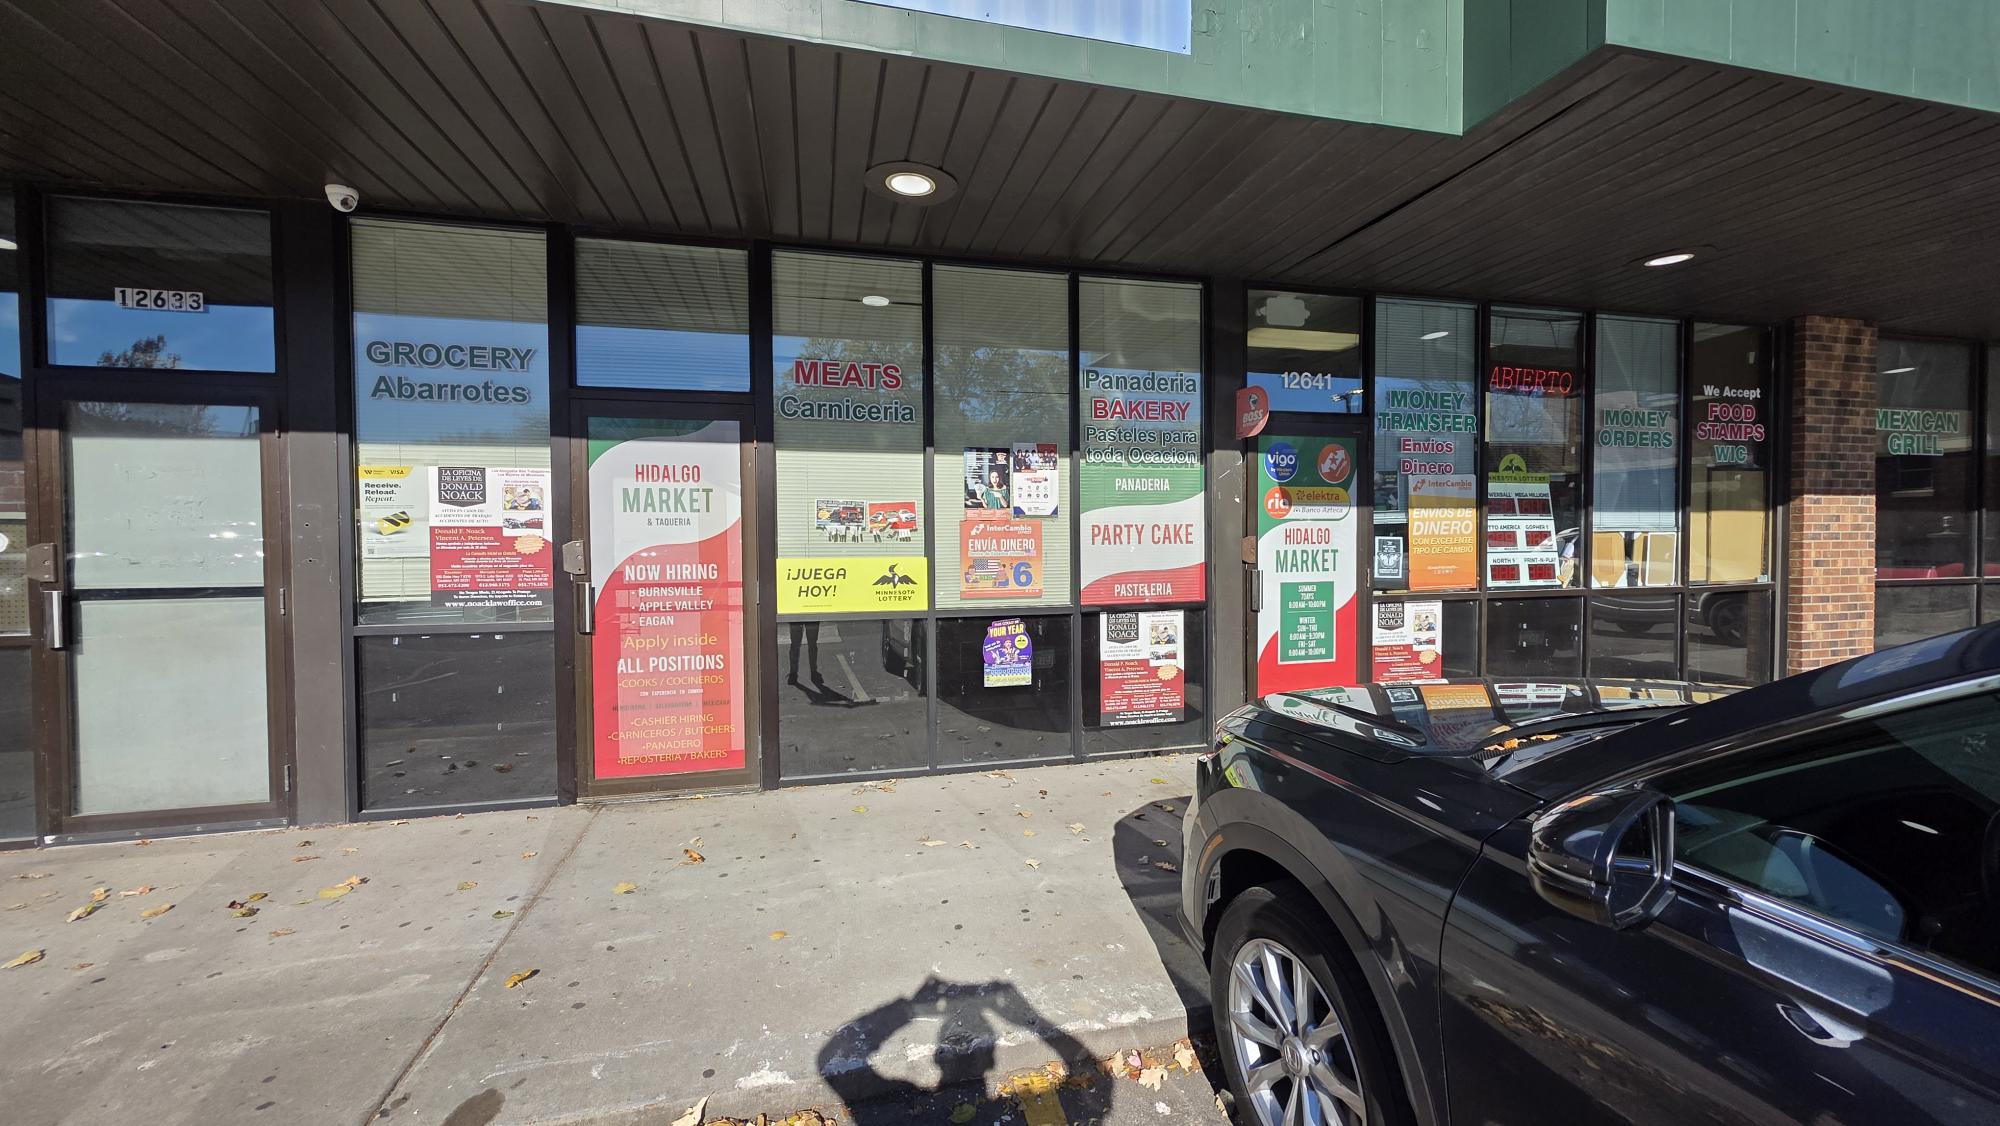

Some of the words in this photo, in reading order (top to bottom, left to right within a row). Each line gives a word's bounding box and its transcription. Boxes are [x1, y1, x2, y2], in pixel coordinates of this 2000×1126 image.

[118, 289, 202, 310] 12633
[366, 340, 536, 371] GROCERY
[794, 359, 902, 390] MEATS
[1083, 369, 1197, 393] Panaderia
[1281, 371, 1332, 390] 12641
[1489, 367, 1573, 394] ABIERTO
[370, 375, 529, 403] Abarrotes
[1703, 384, 1720, 397] We
[1722, 385, 1761, 400] Accept
[1390, 389, 1467, 410] MONEY
[779, 394, 916, 423] Carniceria
[1092, 398, 1191, 421] BAKERY
[1242, 409, 1264, 424] BOSS
[1707, 402, 1756, 422] FOOD
[1378, 411, 1477, 433] TRANSFER
[1603, 409, 1670, 428] MONEY
[1875, 408, 1959, 433] MEXICAN
[1085, 426, 1157, 443] Pasteles
[1162, 430, 1197, 446] para
[1599, 429, 1673, 448] ORDERS
[1696, 423, 1765, 442] STAMPS
[1400, 437, 1453, 453] Envios
[1888, 432, 1944, 456] GRILL
[1086, 447, 1123, 463] toda
[1128, 447, 1197, 464] Ocacion
[1267, 452, 1296, 467] vigo
[1714, 445, 1748, 463] WIC
[635, 464, 701, 483] HIDALGO
[1400, 459, 1453, 475] Dinero
[440, 482, 483, 490] DONALD
[1115, 478, 1170, 491] PANADERIA
[1428, 480, 1472, 488] InterCambio
[364, 495, 395, 504] Repeat.
[440, 490, 484, 500] NOACK
[622, 487, 714, 513] MARKET
[1267, 493, 1289, 510] ria
[1306, 490, 1340, 501] elektra
[1412, 508, 1455, 519] ENVIOS
[1456, 507, 1473, 518] DE
[647, 518, 653, 526] &
[656, 517, 691, 526] TAQUERIA
[986, 524, 1032, 532] InterCambio
[1412, 520, 1473, 536] DINERO
[1091, 524, 1145, 546] PARTY
[1151, 523, 1194, 545] CAKE
[1284, 528, 1331, 545] HIDALGO
[1412, 537, 1430, 545] CON
[1431, 536, 1474, 545] EXCELENTE
[968, 537, 997, 551] ENVÍA
[1000, 538, 1035, 551] DINERO
[1431, 546, 1442, 554] DE
[1443, 545, 1473, 554] CAMBIO
[1275, 549, 1339, 573] MARKET
[625, 564, 660, 581] NOW
[666, 563, 718, 580] HIRING
[786, 567, 847, 581] ¡JUEGA
[638, 586, 703, 597] BURNSVILLE
[798, 585, 837, 598] HOY!
[1114, 583, 1173, 597] PASTELERIA
[445, 599, 543, 607] www.noacklawoffice.com
[639, 600, 673, 612] APPLE
[674, 599, 714, 611] VALLEY
[639, 615, 674, 627] EAGAN
[1299, 616, 1316, 624] WINTER
[989, 626, 1007, 638] YOUR
[1007, 623, 1024, 635] YEAR
[1108, 630, 1138, 638] NOACK
[623, 635, 669, 651] Apply
[673, 633, 718, 647] inside
[617, 657, 644, 674] ALL
[649, 654, 725, 672] POSITIONS
[666, 675, 724, 687] COCINEROS
[678, 713, 714, 724] HIRING
[685, 724, 736, 735] BUTCHERS
[690, 749, 728, 760] BAKERS
